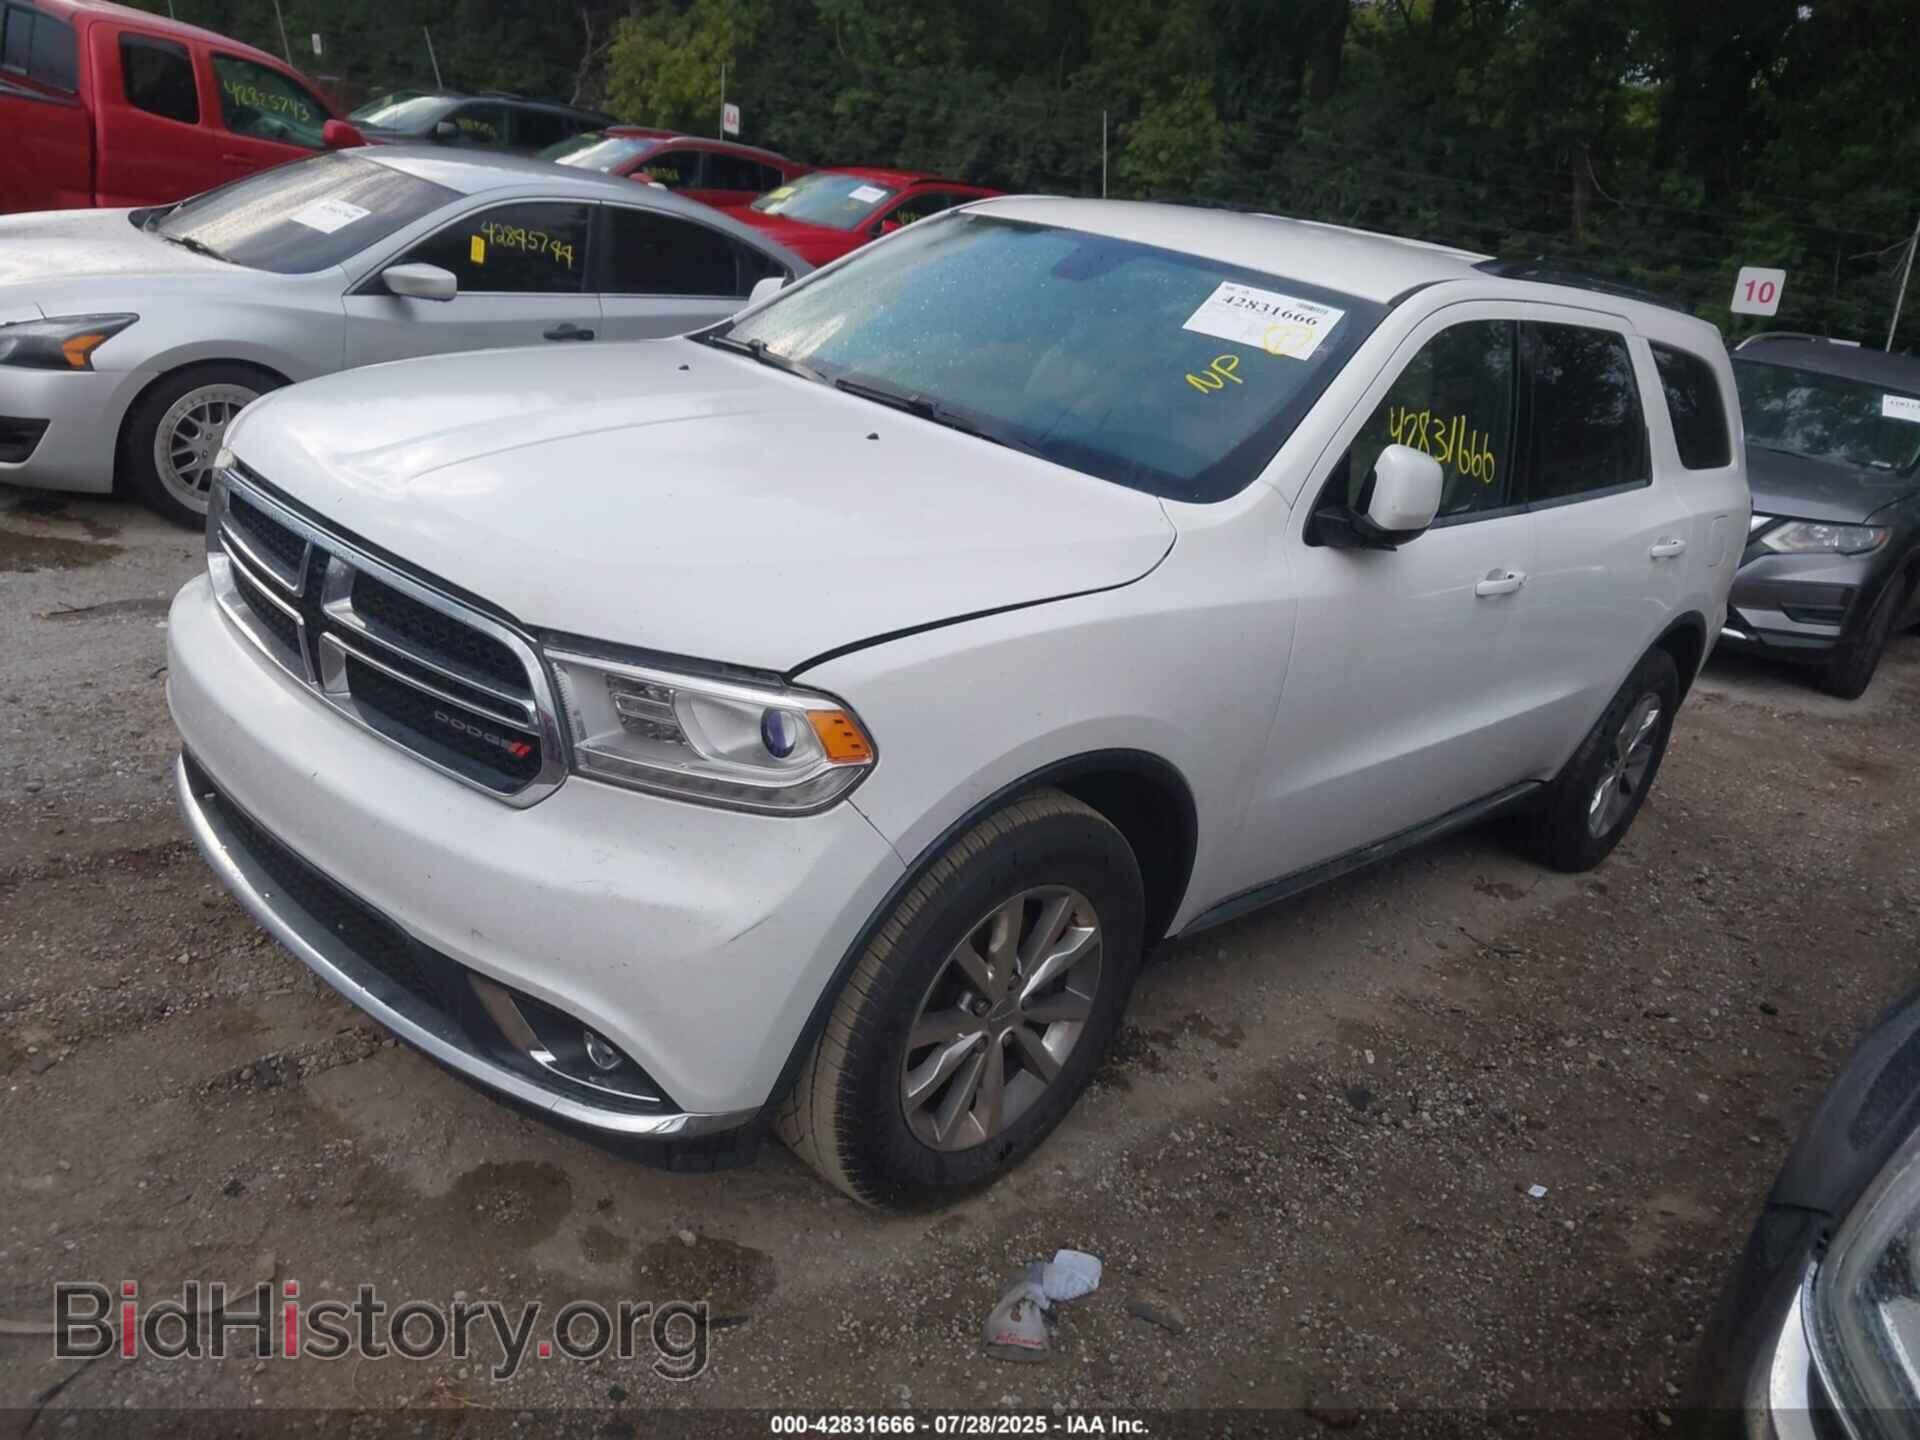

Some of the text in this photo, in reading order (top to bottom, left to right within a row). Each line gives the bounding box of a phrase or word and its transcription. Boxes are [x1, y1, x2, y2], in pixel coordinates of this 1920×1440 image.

[1745, 280, 1775, 304] 10
[1221, 294, 1319, 327] 42831666
[1185, 354, 1244, 394] NP
